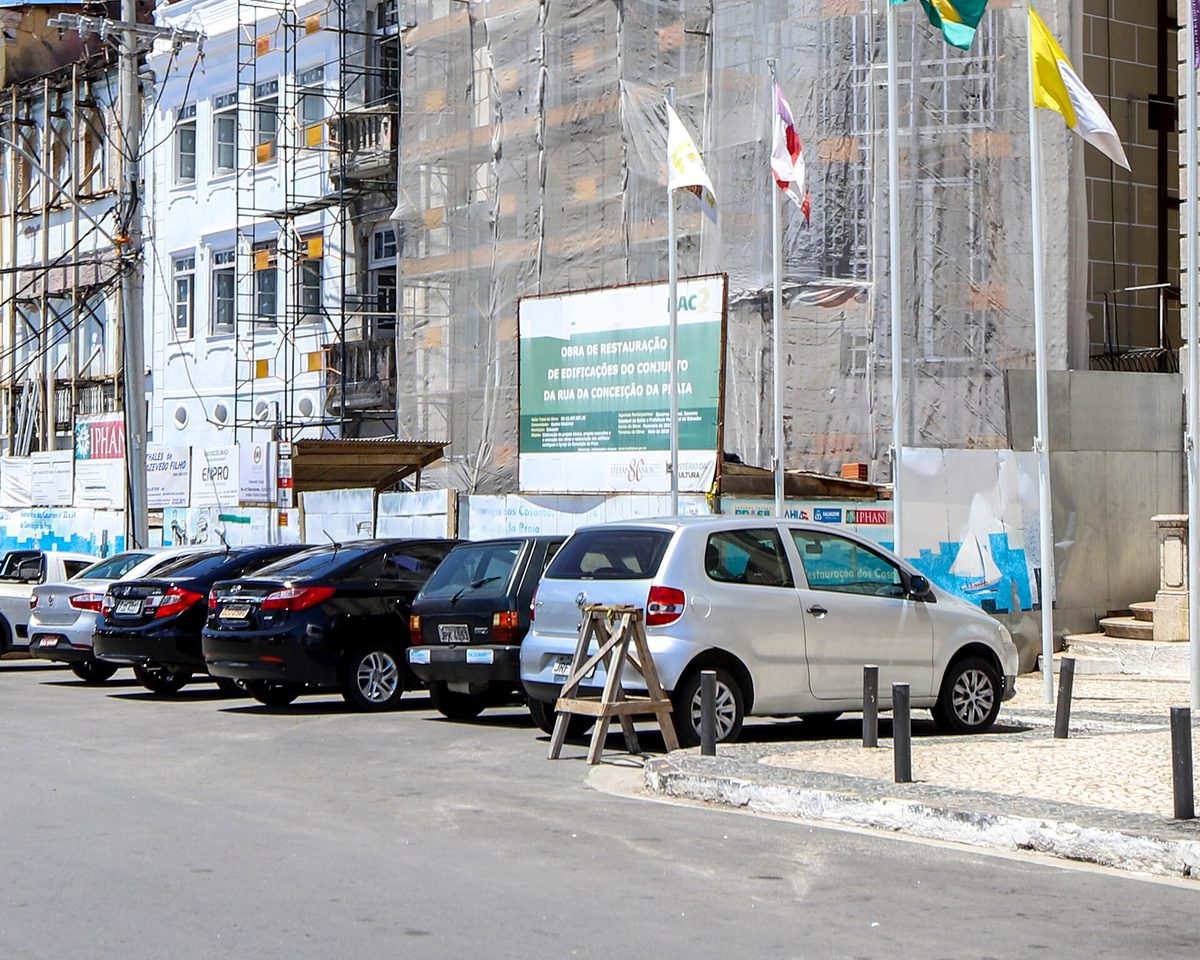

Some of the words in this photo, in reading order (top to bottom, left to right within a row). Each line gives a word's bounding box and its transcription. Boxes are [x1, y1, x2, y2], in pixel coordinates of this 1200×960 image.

[561, 343, 584, 357] OBRA
[587, 343, 598, 355] DE
[600, 336, 667, 354] RESTAURAÇÃO
[548, 369, 559, 380] DE
[561, 363, 618, 379] EDIFICAÇÕES
[621, 363, 634, 374] DO
[544, 390, 555, 401] DA
[558, 389, 574, 400] RUA
[577, 388, 589, 399] DA
[591, 383, 643, 399] CONCEIÇÃO
[646, 384, 659, 395] DA
[170, 460, 187, 470] FILHO
[856, 511, 886, 523] IPHAN
[519, 522, 540, 533] Praia
[857, 568, 872, 577] dos
